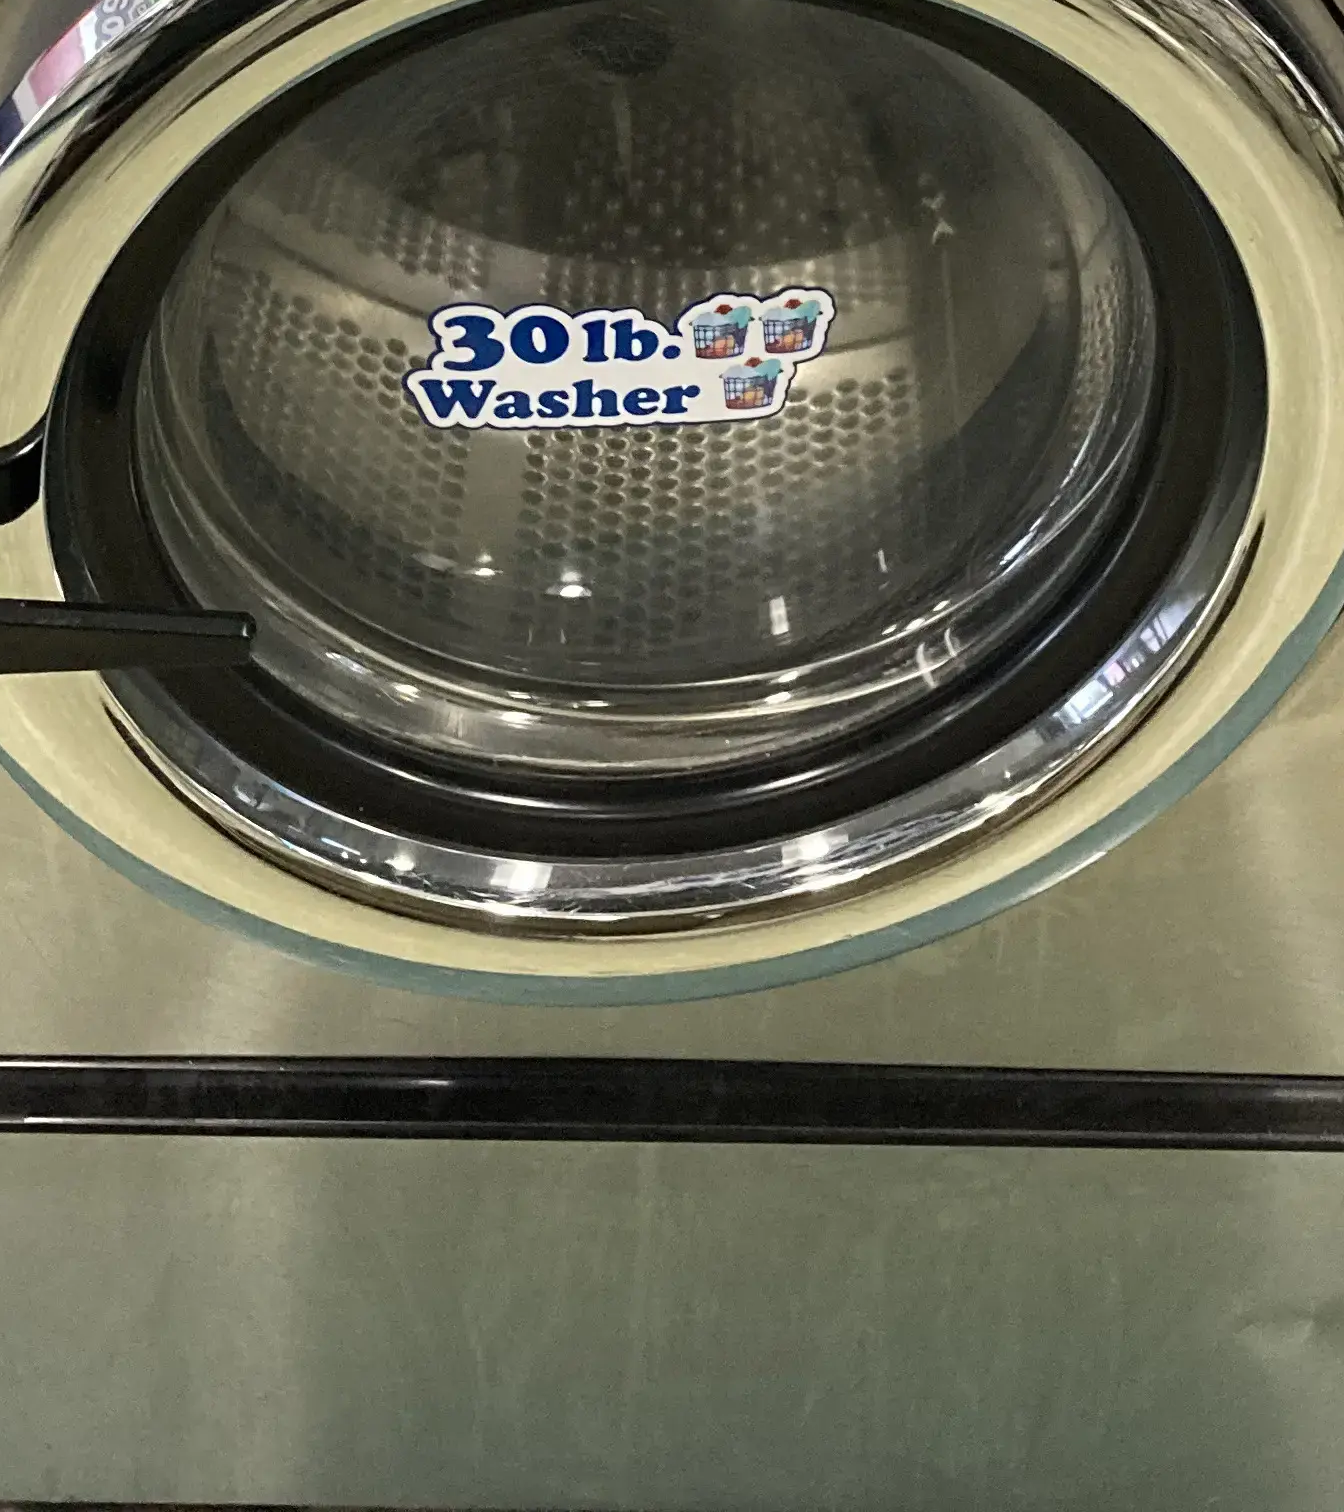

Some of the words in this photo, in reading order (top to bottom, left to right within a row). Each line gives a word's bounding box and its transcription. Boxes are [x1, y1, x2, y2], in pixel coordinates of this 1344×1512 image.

[442, 314, 570, 373] 30
[582, 319, 682, 362] lb.
[419, 378, 701, 419] Washer
